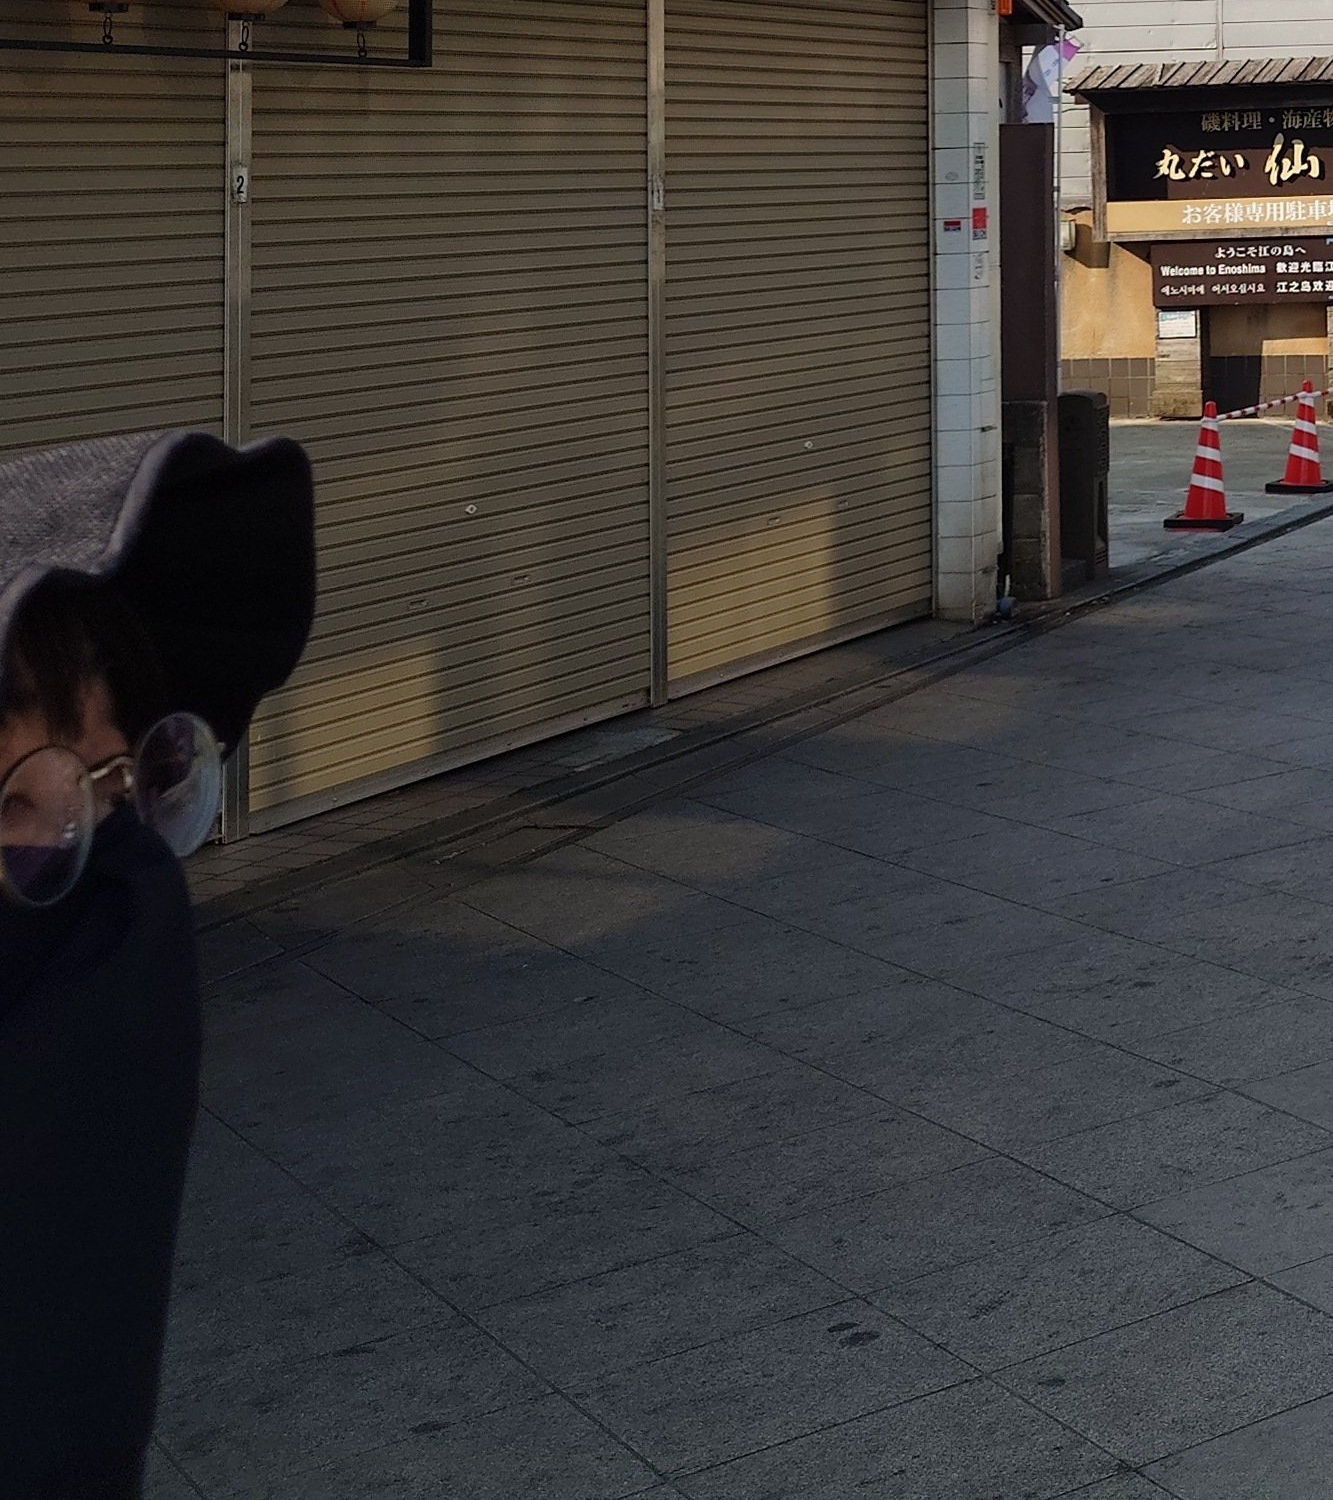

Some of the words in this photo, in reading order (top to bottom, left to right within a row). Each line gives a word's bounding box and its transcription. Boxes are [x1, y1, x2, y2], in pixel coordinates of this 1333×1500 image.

[1153, 148, 1246, 181] 丸だい
[1214, 244, 1308, 259] ようこそ江の島へ
[1160, 263, 1203, 277] Welcome
[1206, 264, 1216, 276] to
[1217, 262, 1266, 276] Enoshima
